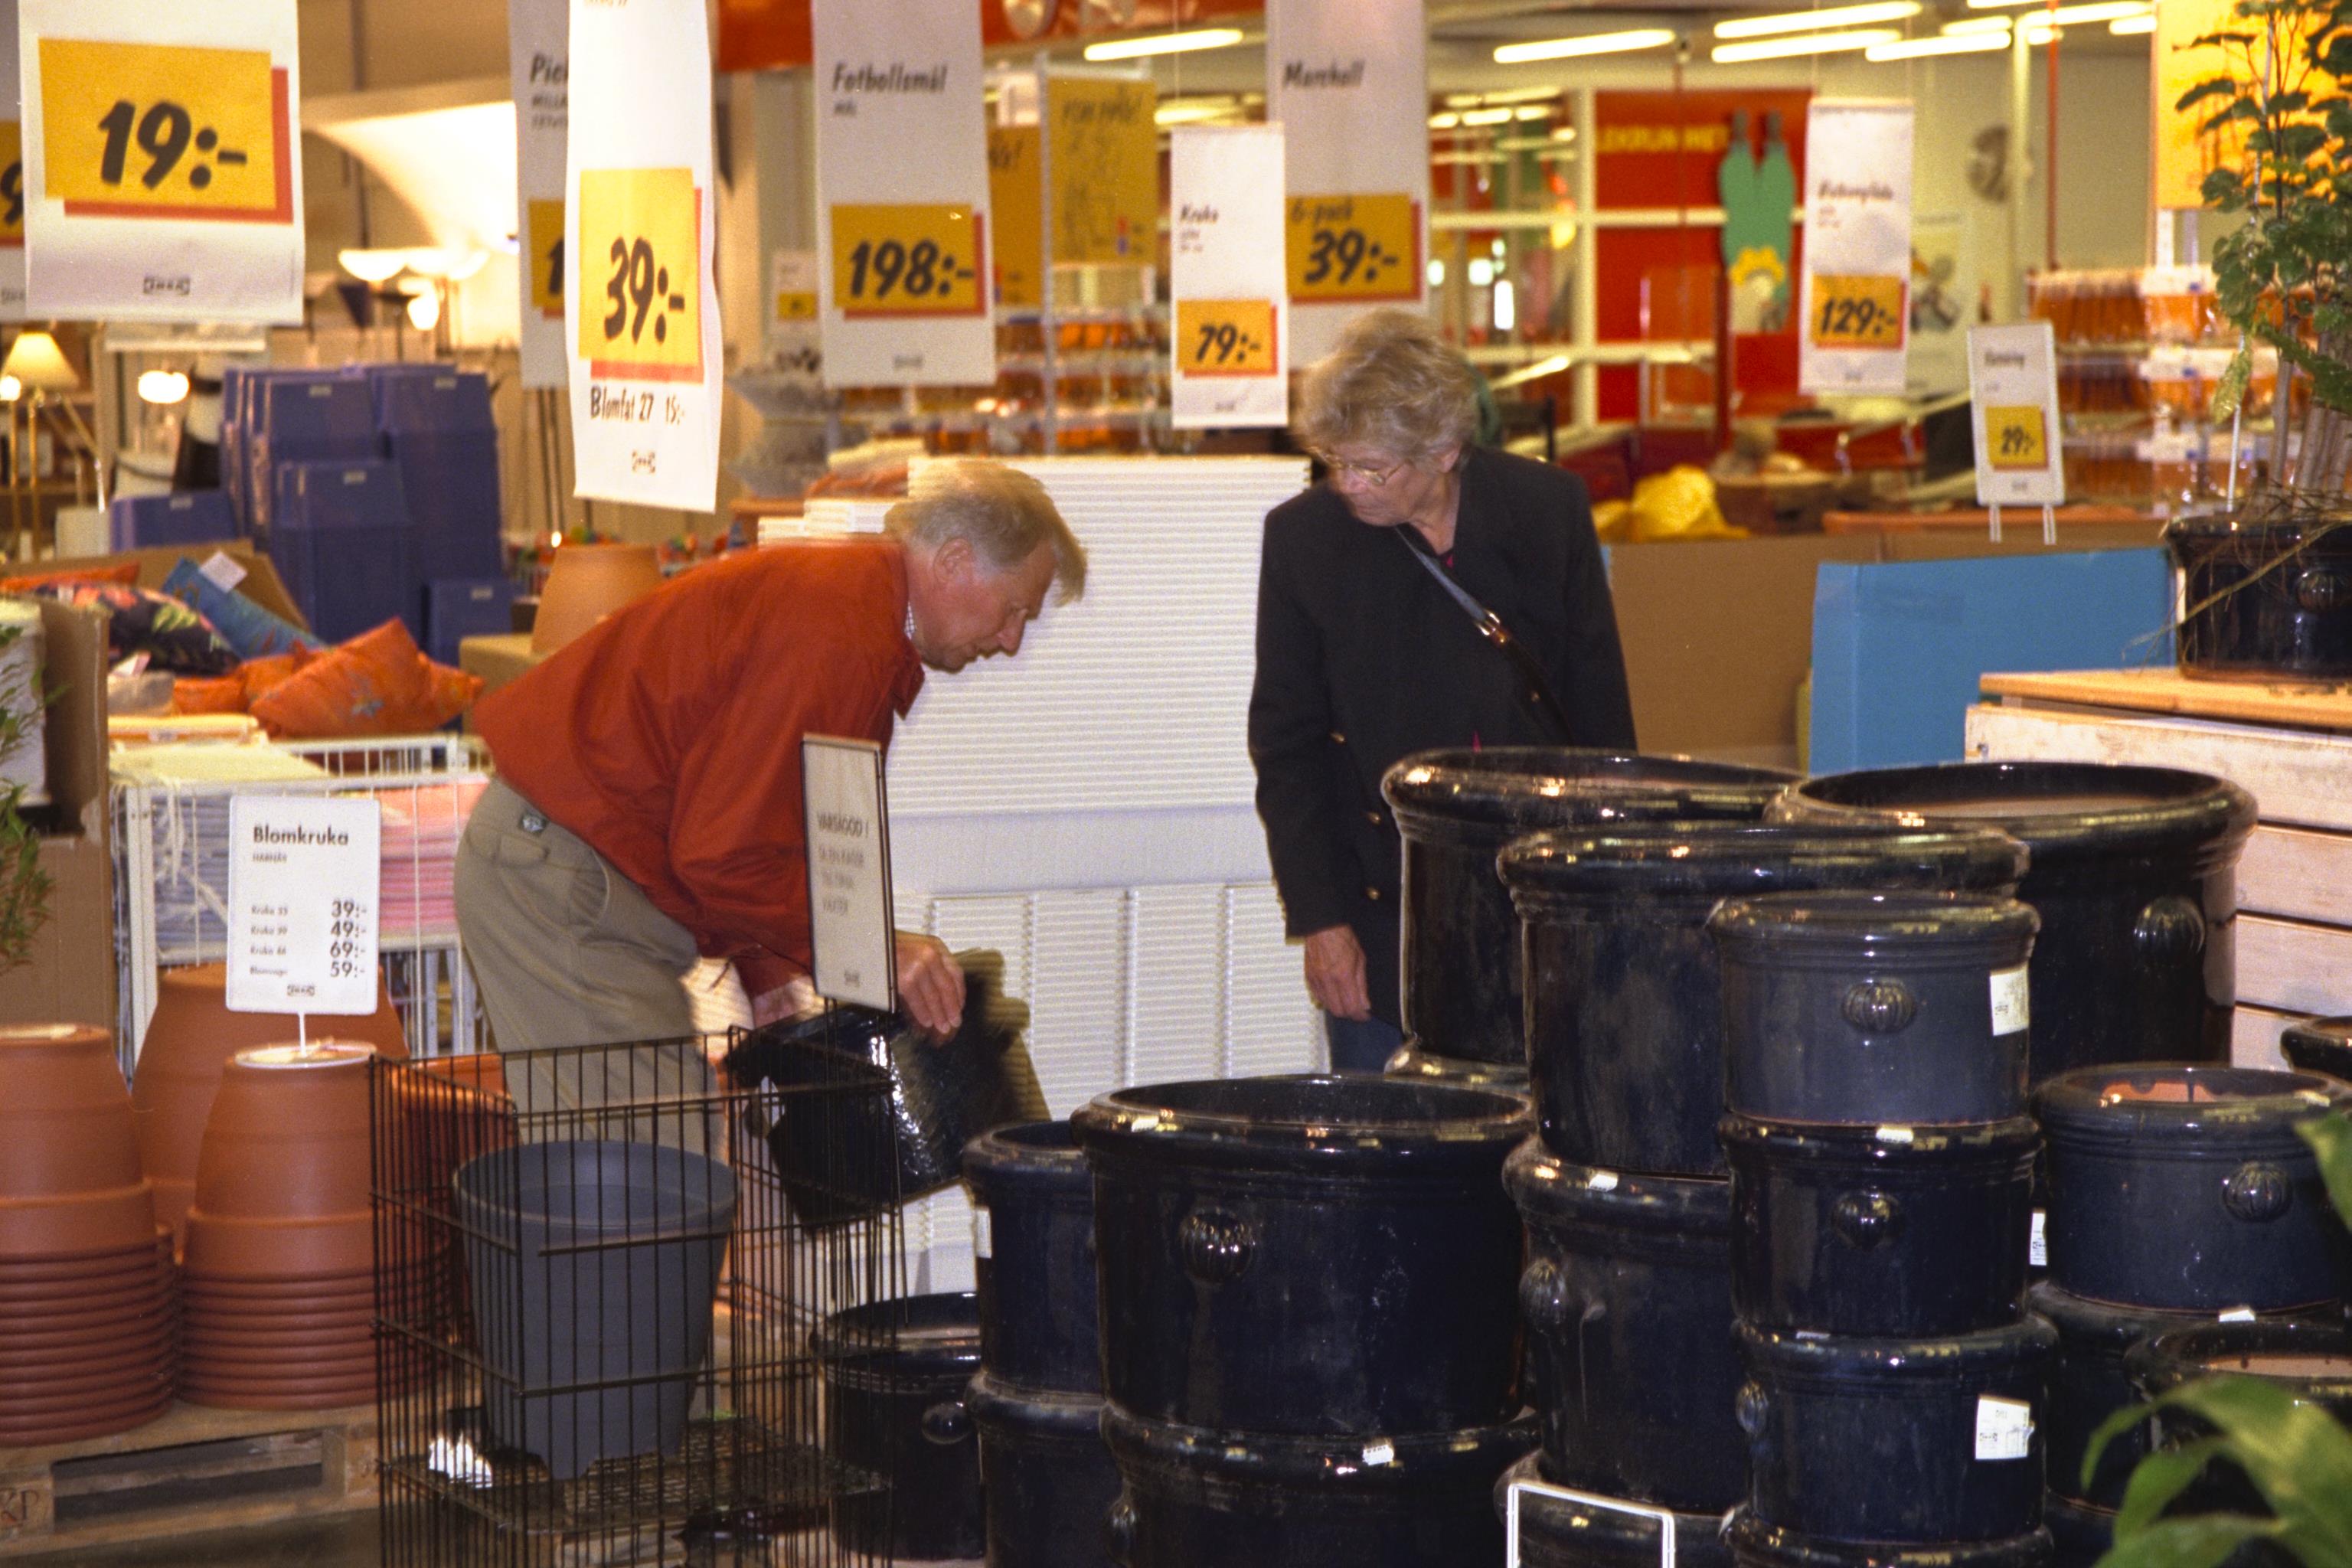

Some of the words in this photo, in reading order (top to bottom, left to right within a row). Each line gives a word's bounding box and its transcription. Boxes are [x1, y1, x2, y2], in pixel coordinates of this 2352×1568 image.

[98, 100, 247, 190] 19:-
[850, 240, 975, 298] 198:-
[1304, 229, 1399, 283] 39:-
[604, 236, 684, 345] 39:-
[1820, 297, 1896, 335] 129:-
[1195, 322, 1262, 364] 79:-
[253, 823, 349, 846] Blomkruka
[332, 899, 368, 918] 39:-
[331, 920, 367, 939] 49:-
[330, 940, 366, 959] 69:-
[330, 960, 365, 979] 59:-
